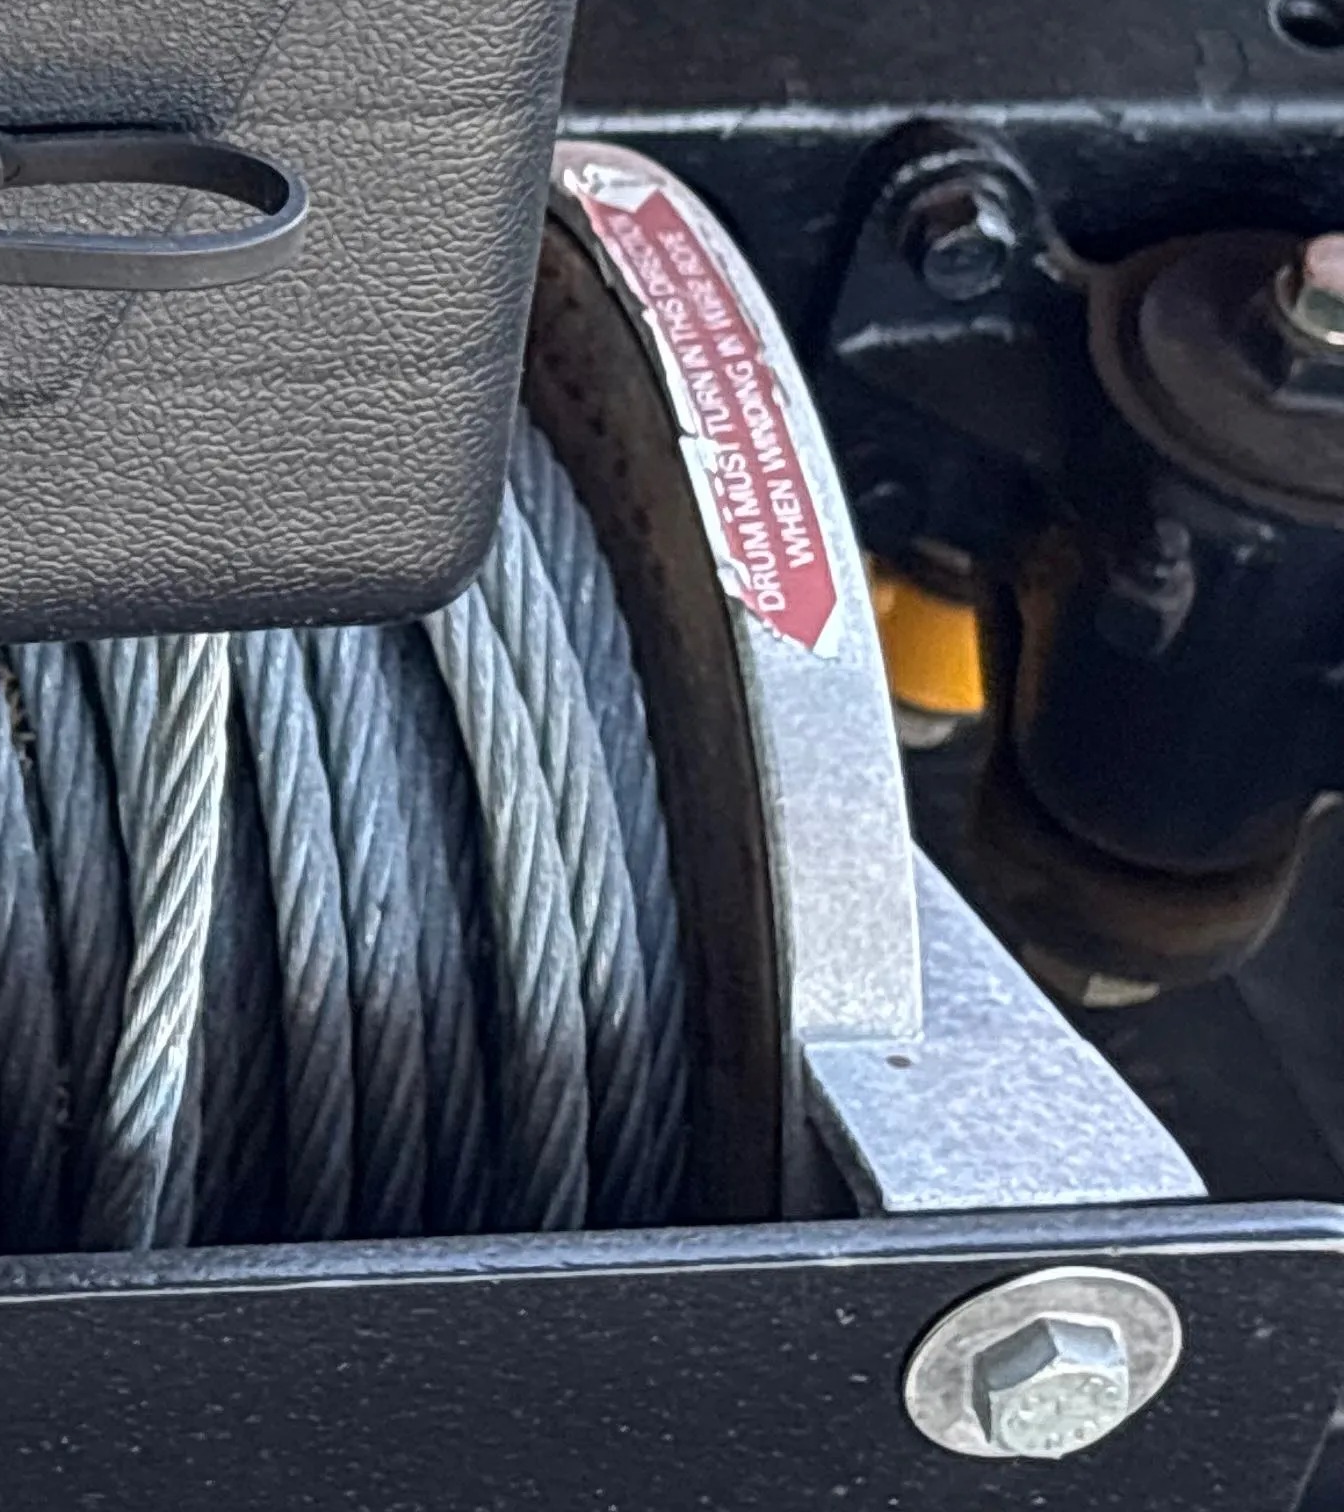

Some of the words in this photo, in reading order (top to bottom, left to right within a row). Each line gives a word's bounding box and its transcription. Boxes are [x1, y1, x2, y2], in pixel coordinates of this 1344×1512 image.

[656, 297, 699, 343] THIS
[712, 333, 746, 357] IN
[676, 344, 710, 369] IN
[688, 368, 736, 438] TURN
[718, 441, 761, 518] MUST
[766, 477, 815, 570] WHEN
[738, 520, 786, 613] DRUM
